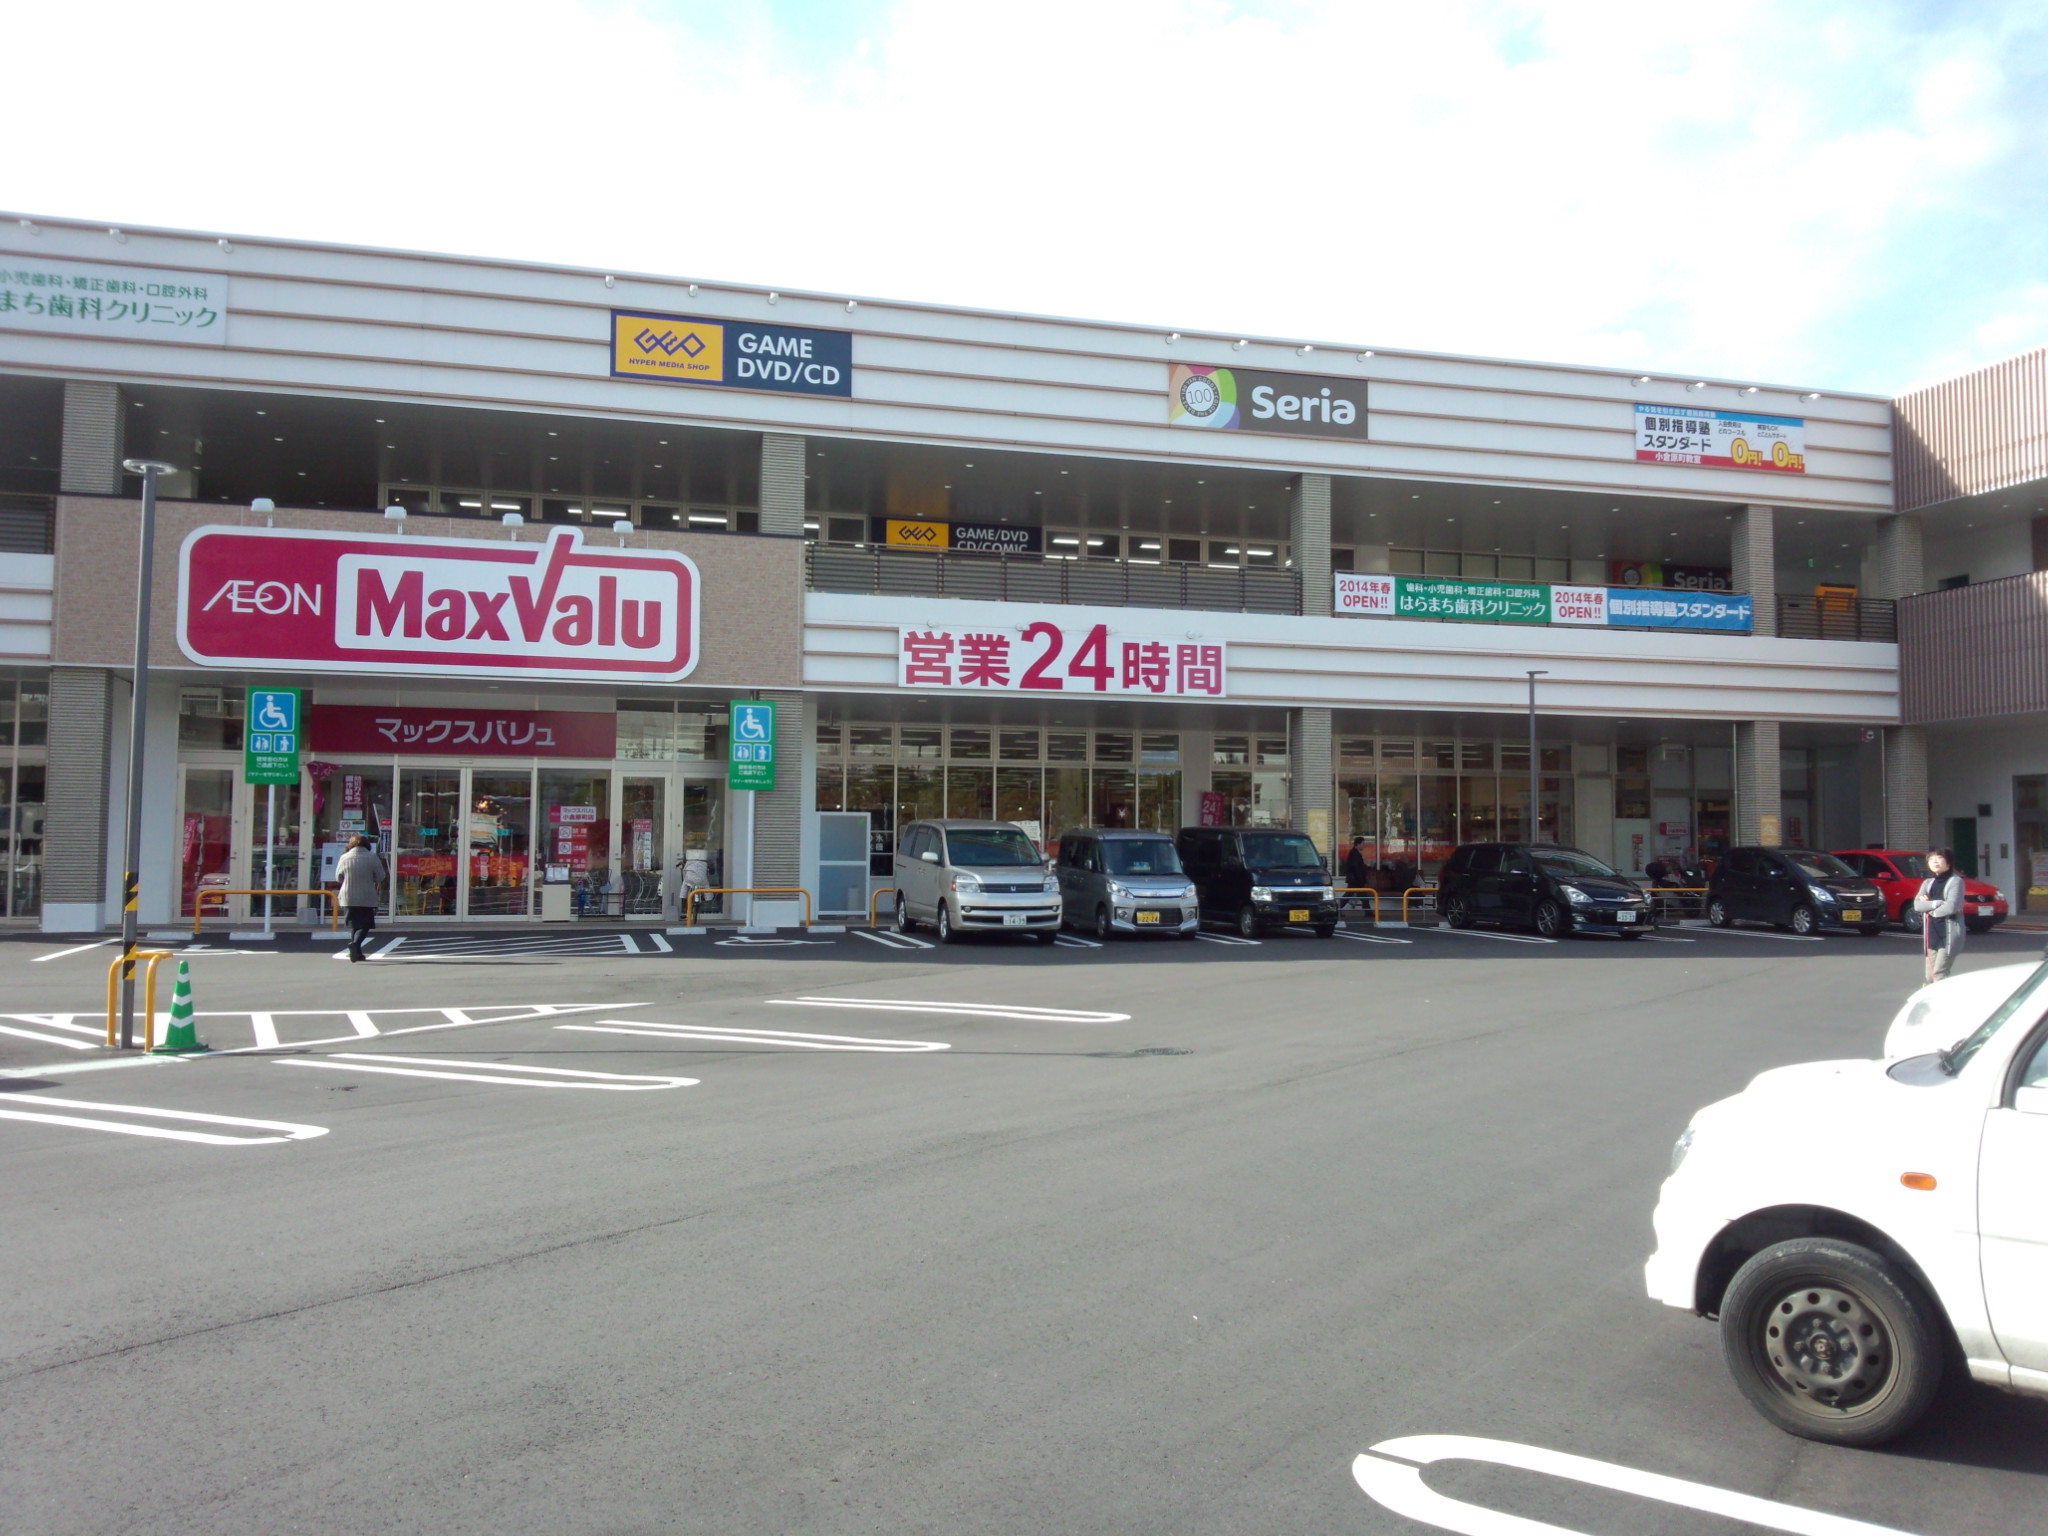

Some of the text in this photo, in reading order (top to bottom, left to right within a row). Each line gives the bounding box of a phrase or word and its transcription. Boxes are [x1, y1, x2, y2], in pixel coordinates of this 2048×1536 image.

[738, 332, 813, 359] GAME
[629, 358, 710, 372] HYPER MEDIA SHOP
[737, 357, 840, 385] DVD/CD
[1187, 388, 1212, 405] 100
[1252, 386, 1356, 425] Seria
[1645, 417, 1711, 436] 個別指導塾
[1644, 434, 1711, 452] スタンダード
[956, 527, 1029, 542] GAME/DVD
[957, 540, 1028, 552] CD/COMIC
[1339, 580, 1391, 594] 2014年春
[1674, 571, 1726, 590] Seria
[356, 534, 662, 649] MaxValu
[1555, 591, 1603, 606] 2014年春
[1400, 595, 1546, 618] はらまち歯科クリニック
[1609, 598, 1750, 621] 個別指導塾スタンダード
[903, 621, 1223, 696] 営業24時間
[375, 718, 556, 746] マックスバリュ
